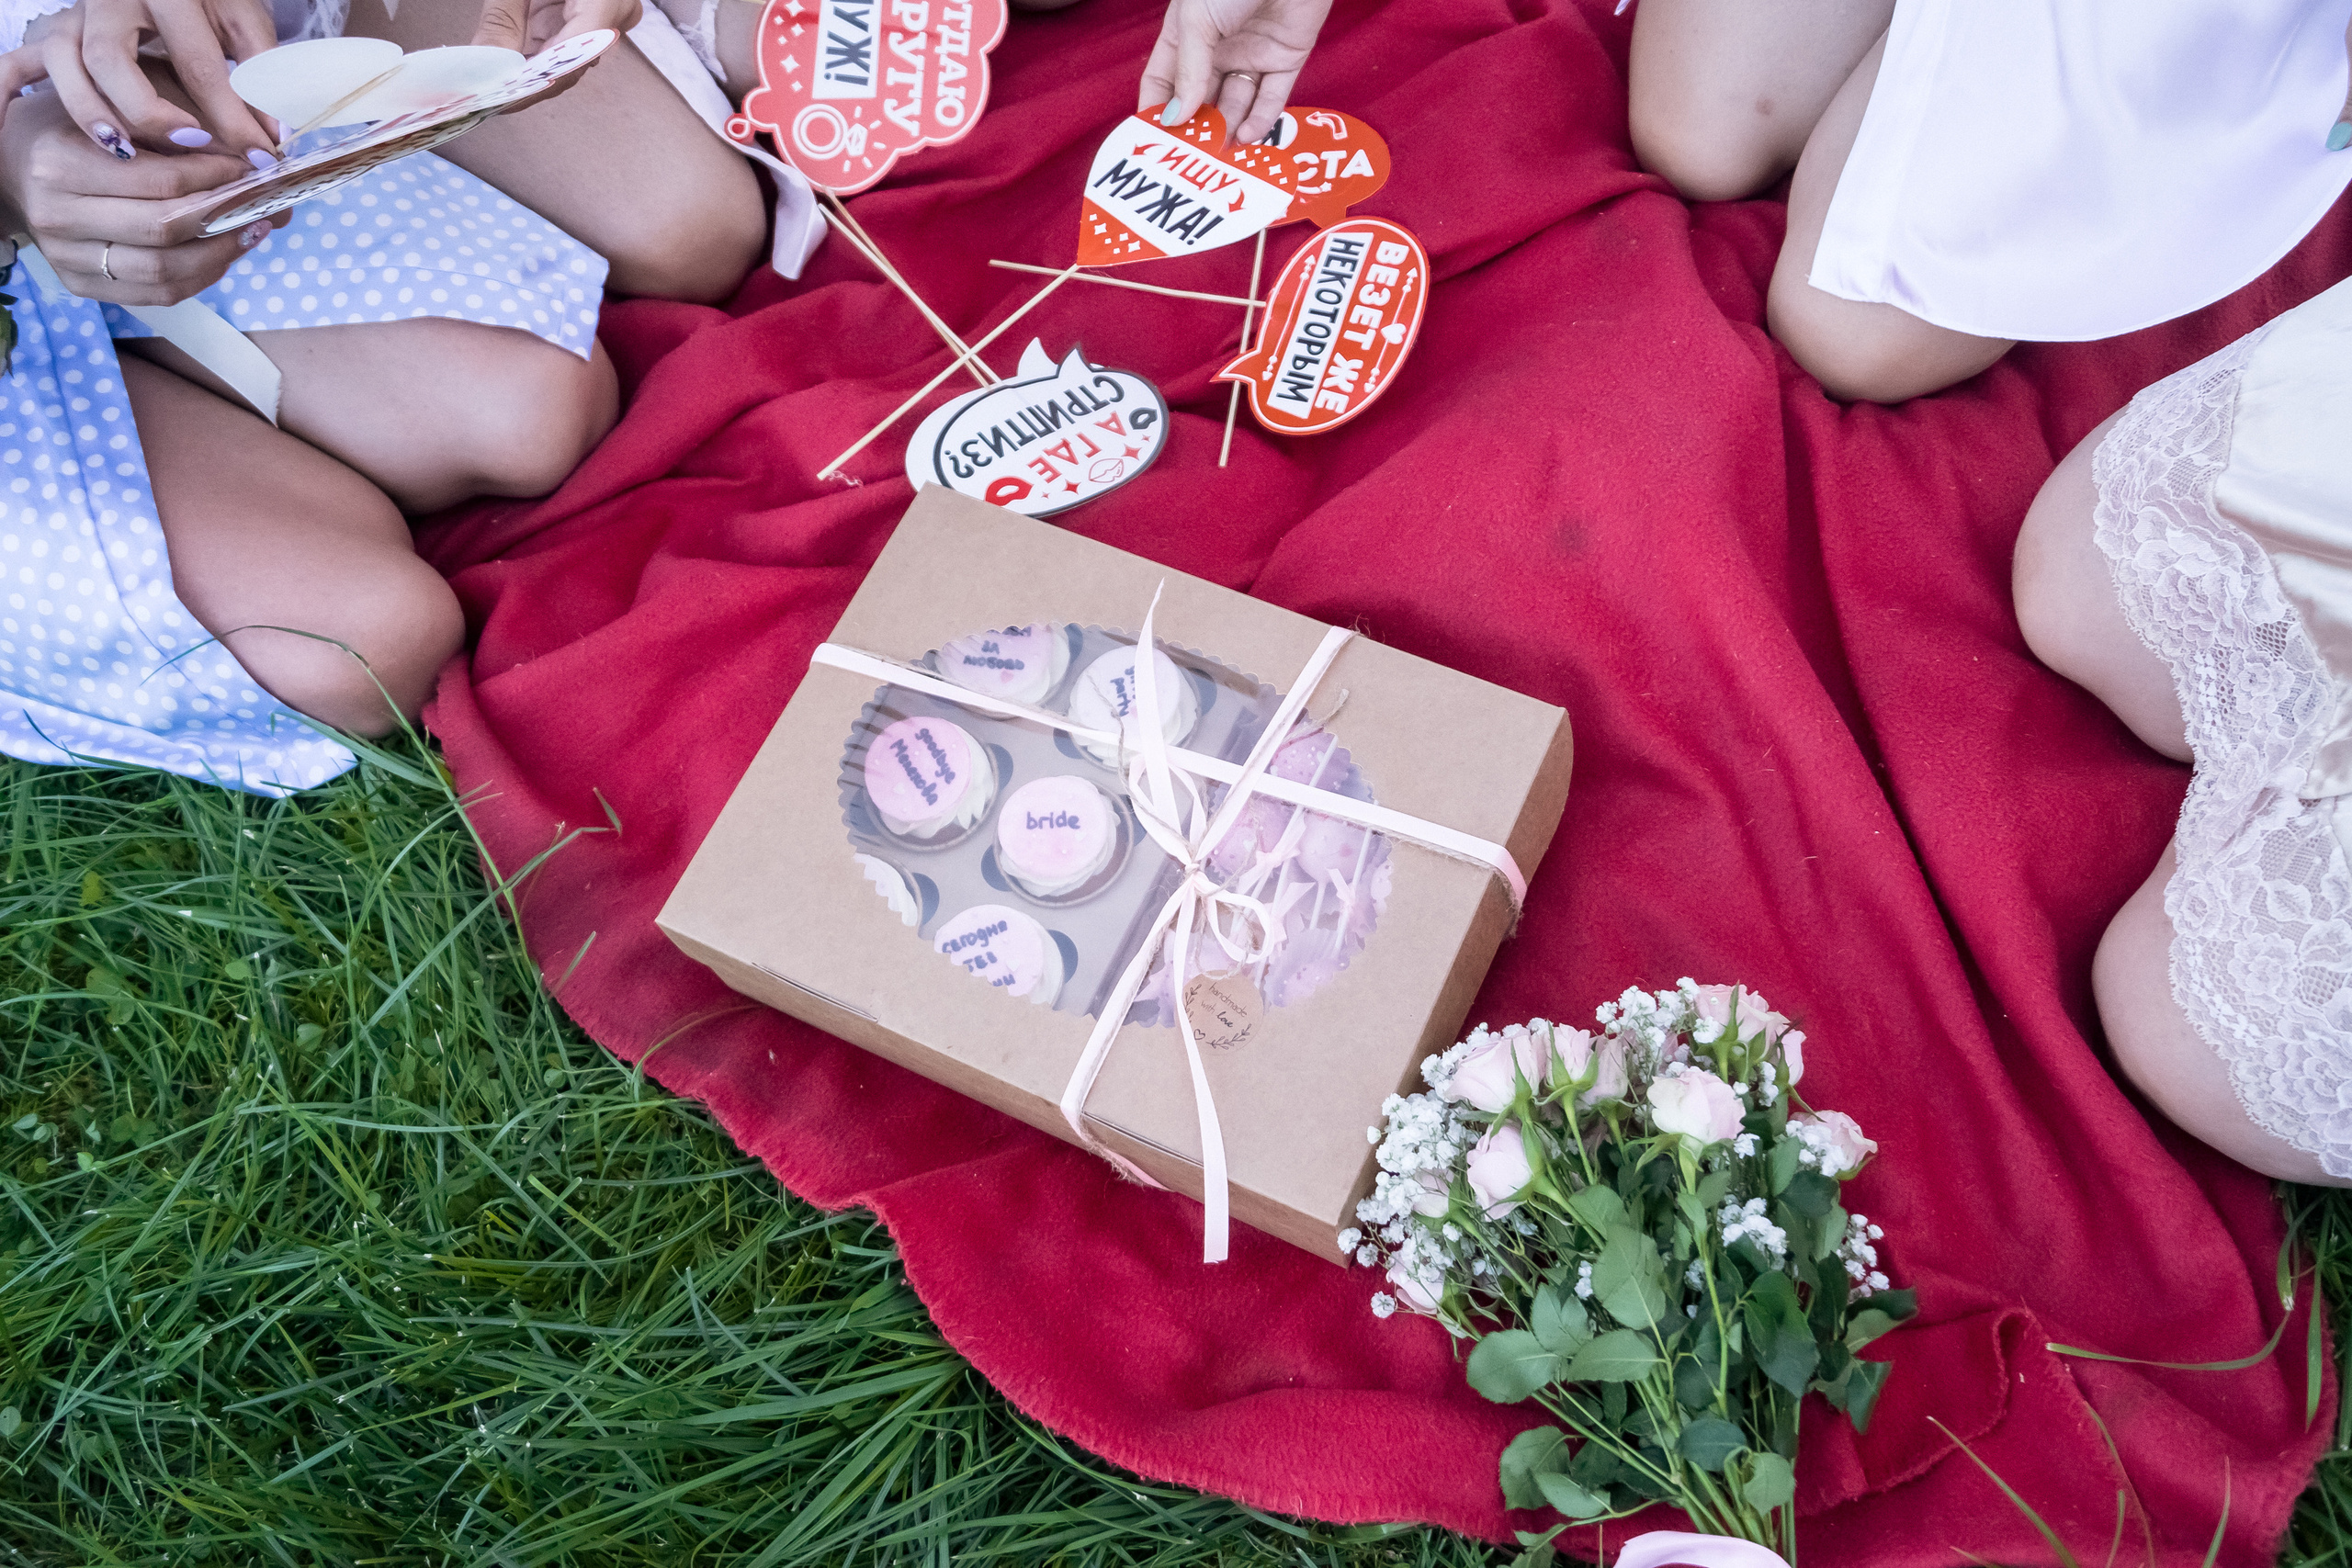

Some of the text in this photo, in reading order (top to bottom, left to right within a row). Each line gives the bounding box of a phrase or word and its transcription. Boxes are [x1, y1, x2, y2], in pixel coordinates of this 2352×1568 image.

[823, 0, 875, 86] УЖ!
[934, 0, 973, 127] ТДАЮ
[1093, 158, 1224, 246] МУЖА!
[1157, 146, 1240, 194] ИЩУ
[1276, 237, 1365, 403] НЕКОТОРЫМ
[1315, 241, 1409, 414] ВЕЗЕТ ЖЕ
[944, 375, 1125, 479] СТРИПТИЗ?
[1027, 411, 1127, 484] А ГДЕ
[1026, 809, 1080, 831] bride
[1201, 1000, 1233, 1027] with love
[1209, 982, 1247, 1017] handmade
